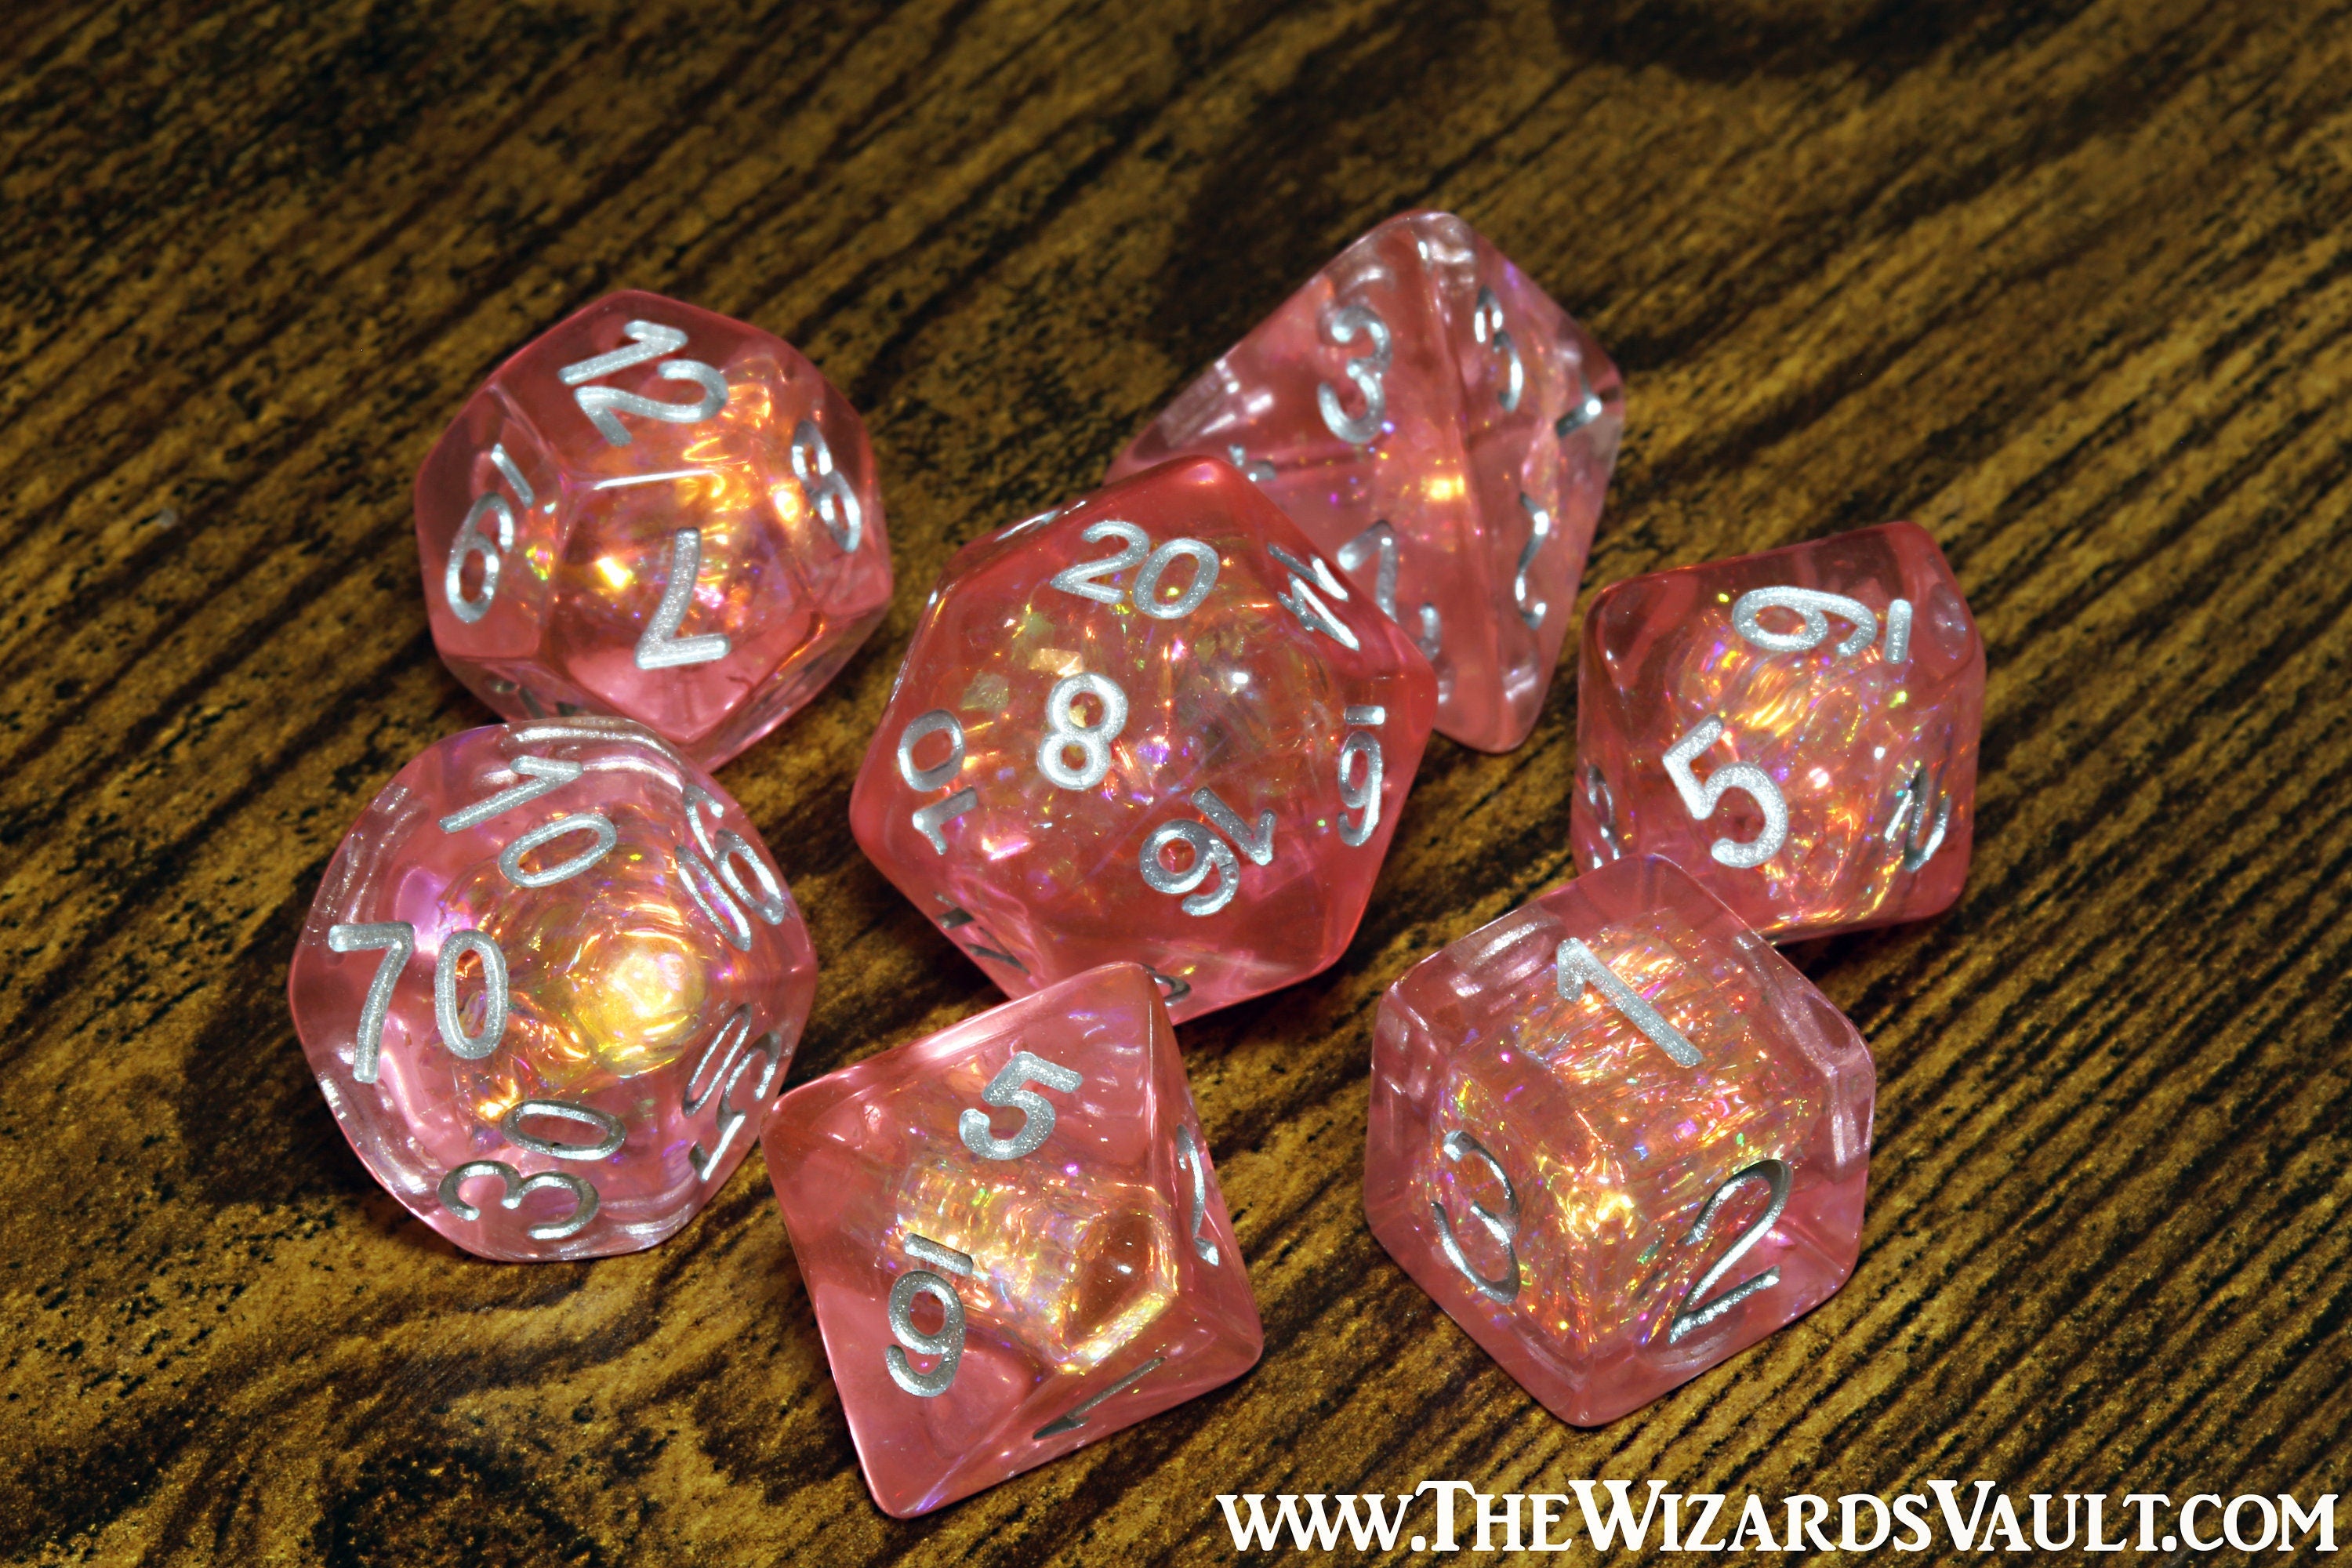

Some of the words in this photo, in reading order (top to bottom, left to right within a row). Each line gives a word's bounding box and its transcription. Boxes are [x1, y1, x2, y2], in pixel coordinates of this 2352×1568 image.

[557, 320, 729, 446] 12
[1317, 304, 1392, 443] 3
[790, 419, 861, 553] 8
[634, 527, 731, 670] 7
[1051, 519, 1220, 619] 20
[897, 709, 978, 855] 10
[1036, 673, 1128, 790] 8
[1661, 713, 1788, 869] 5
[439, 755, 618, 887] 10
[328, 922, 510, 1083] 70
[1557, 938, 1704, 1067] 1
[437, 1099, 627, 1241] 30
[958, 1051, 1083, 1160] 5
[1431, 1130, 1521, 1305] 3
[1670, 1159, 1793, 1345] 2
